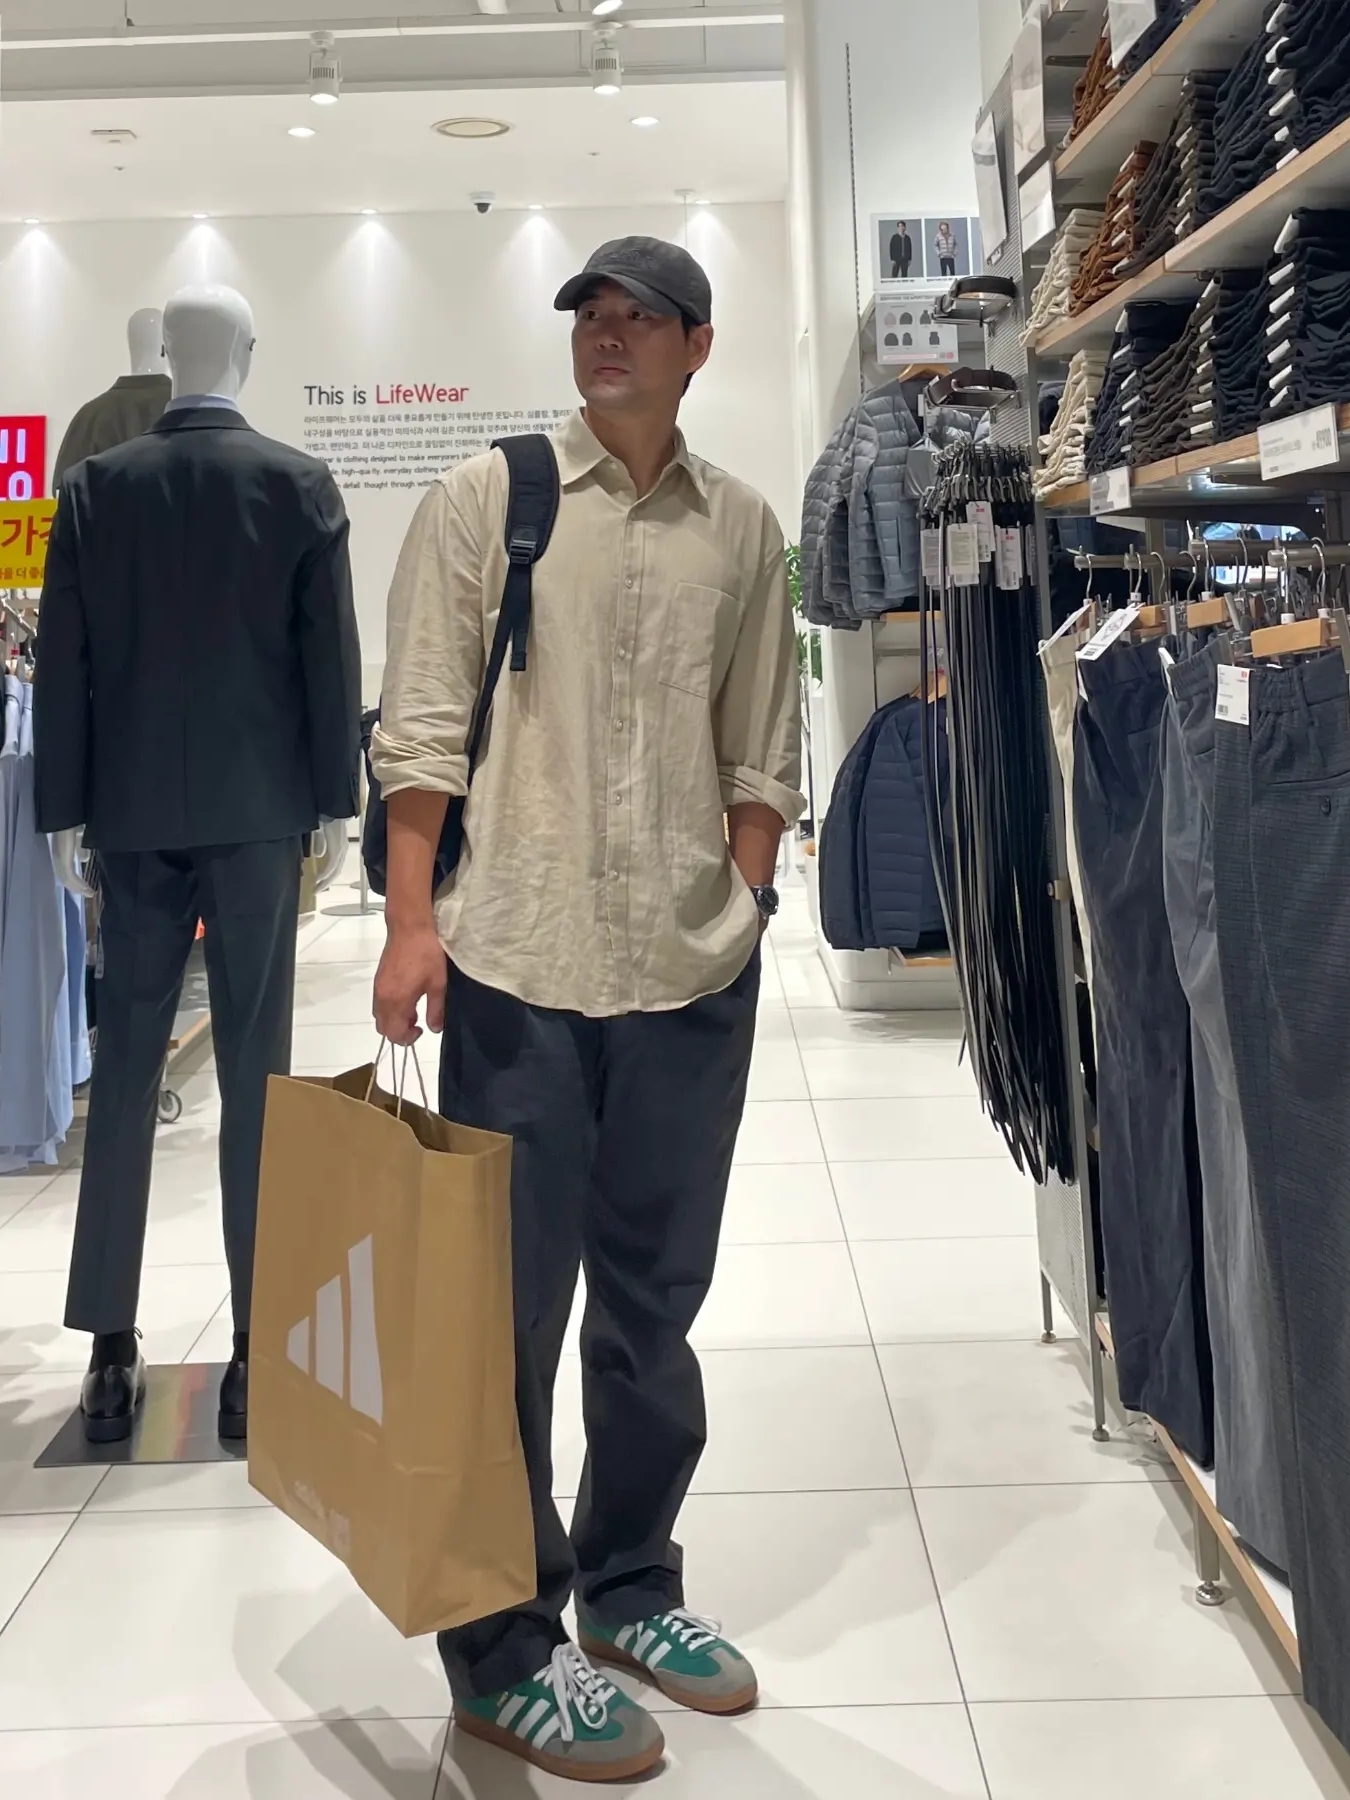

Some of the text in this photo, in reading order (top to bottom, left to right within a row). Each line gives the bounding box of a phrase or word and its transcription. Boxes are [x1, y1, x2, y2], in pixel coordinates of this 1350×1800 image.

[304, 382, 470, 405] This is LifeWear
[344, 456, 368, 464] clothing
[370, 455, 396, 464] designed
[384, 467, 412, 476] everyday
[414, 466, 439, 474] clothing
[364, 480, 388, 490] thought
[390, 480, 415, 490] through
[16, 566, 26, 581] 더
